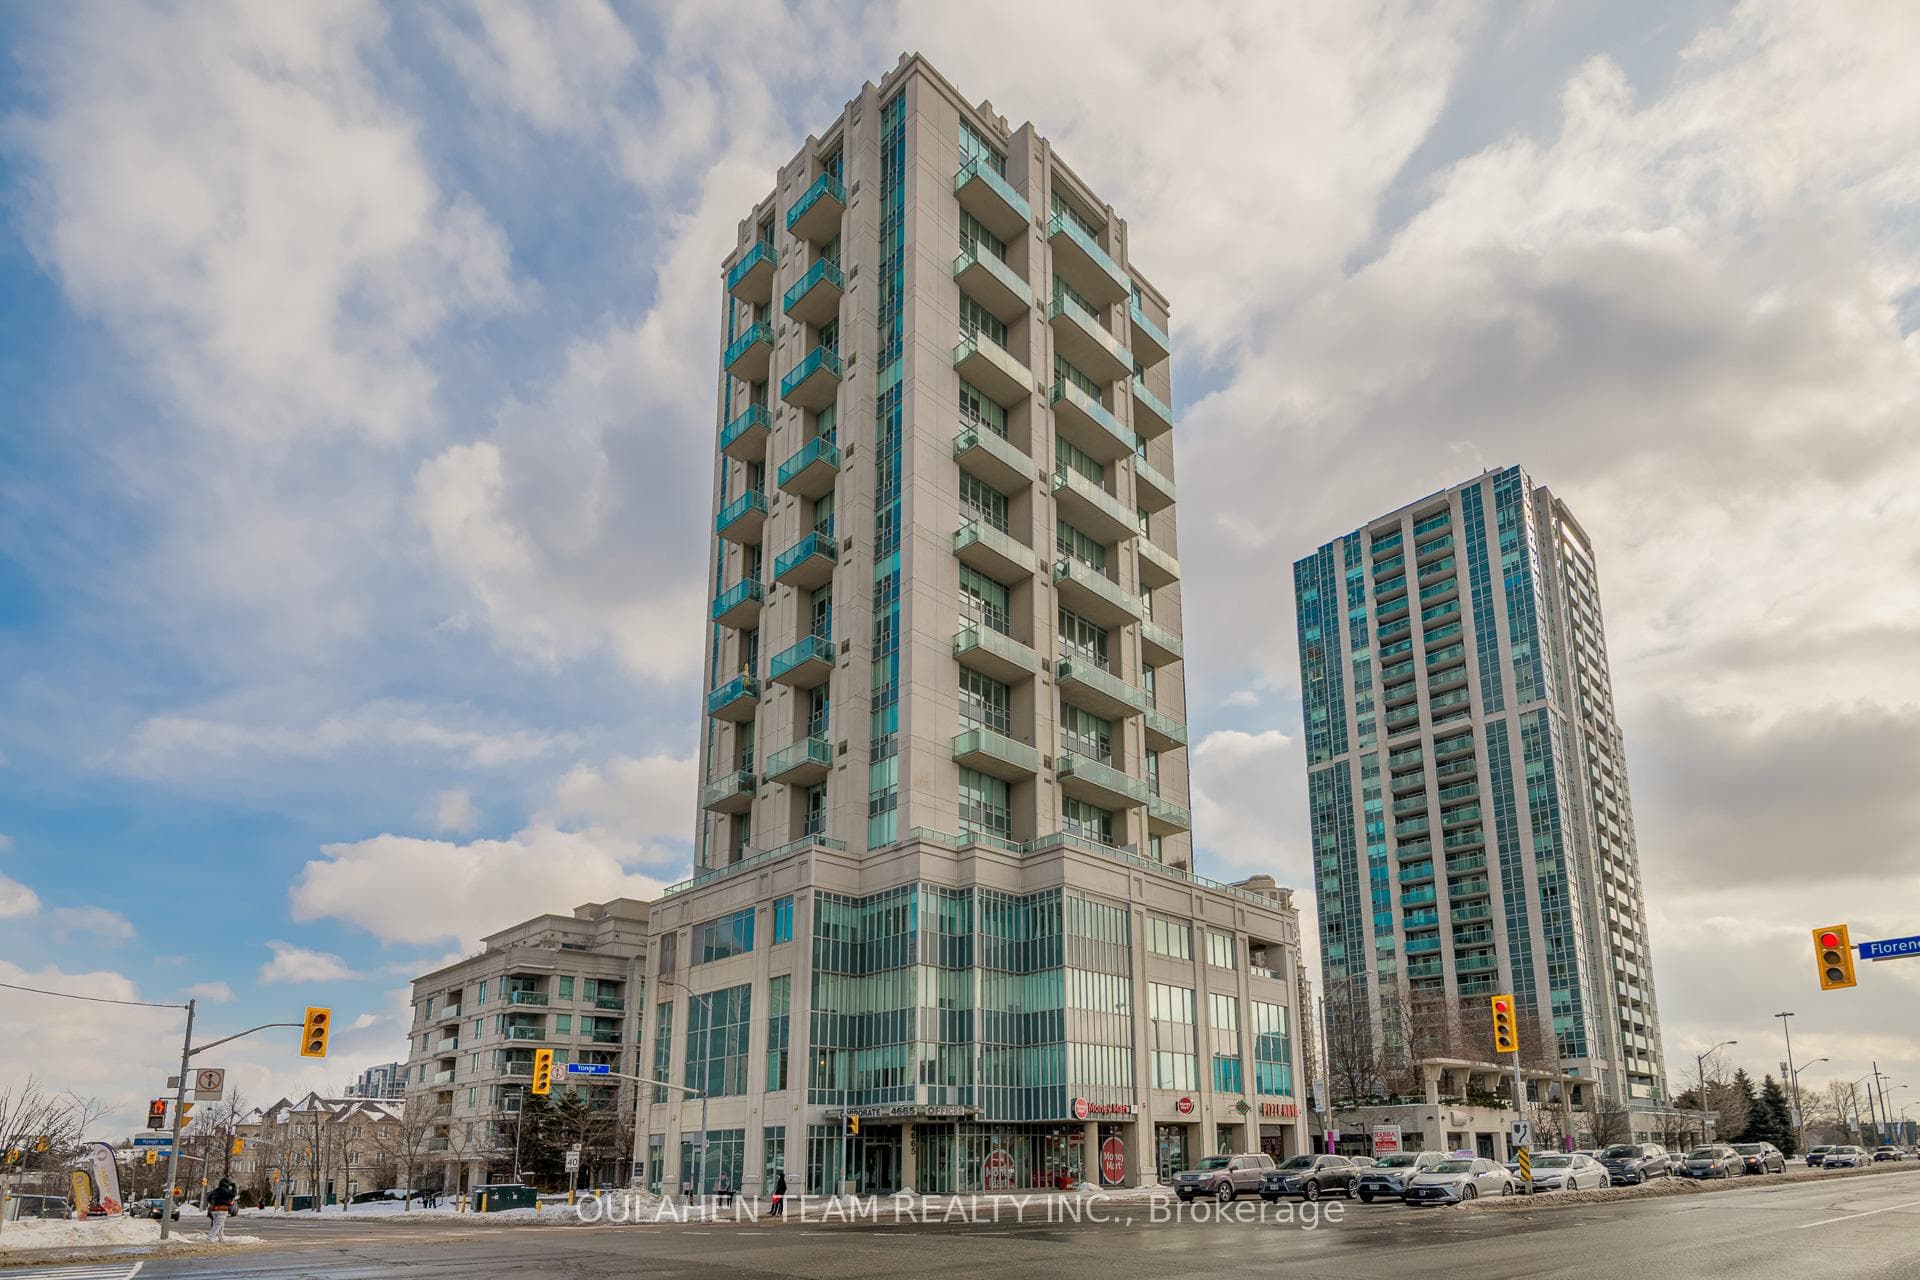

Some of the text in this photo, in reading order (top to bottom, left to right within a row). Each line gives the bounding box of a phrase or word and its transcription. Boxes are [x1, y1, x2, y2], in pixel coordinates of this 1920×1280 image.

[578, 1064, 596, 1074] Yonge
[891, 1107, 916, 1116] 4665
[568, 1158, 578, 1167] 40
